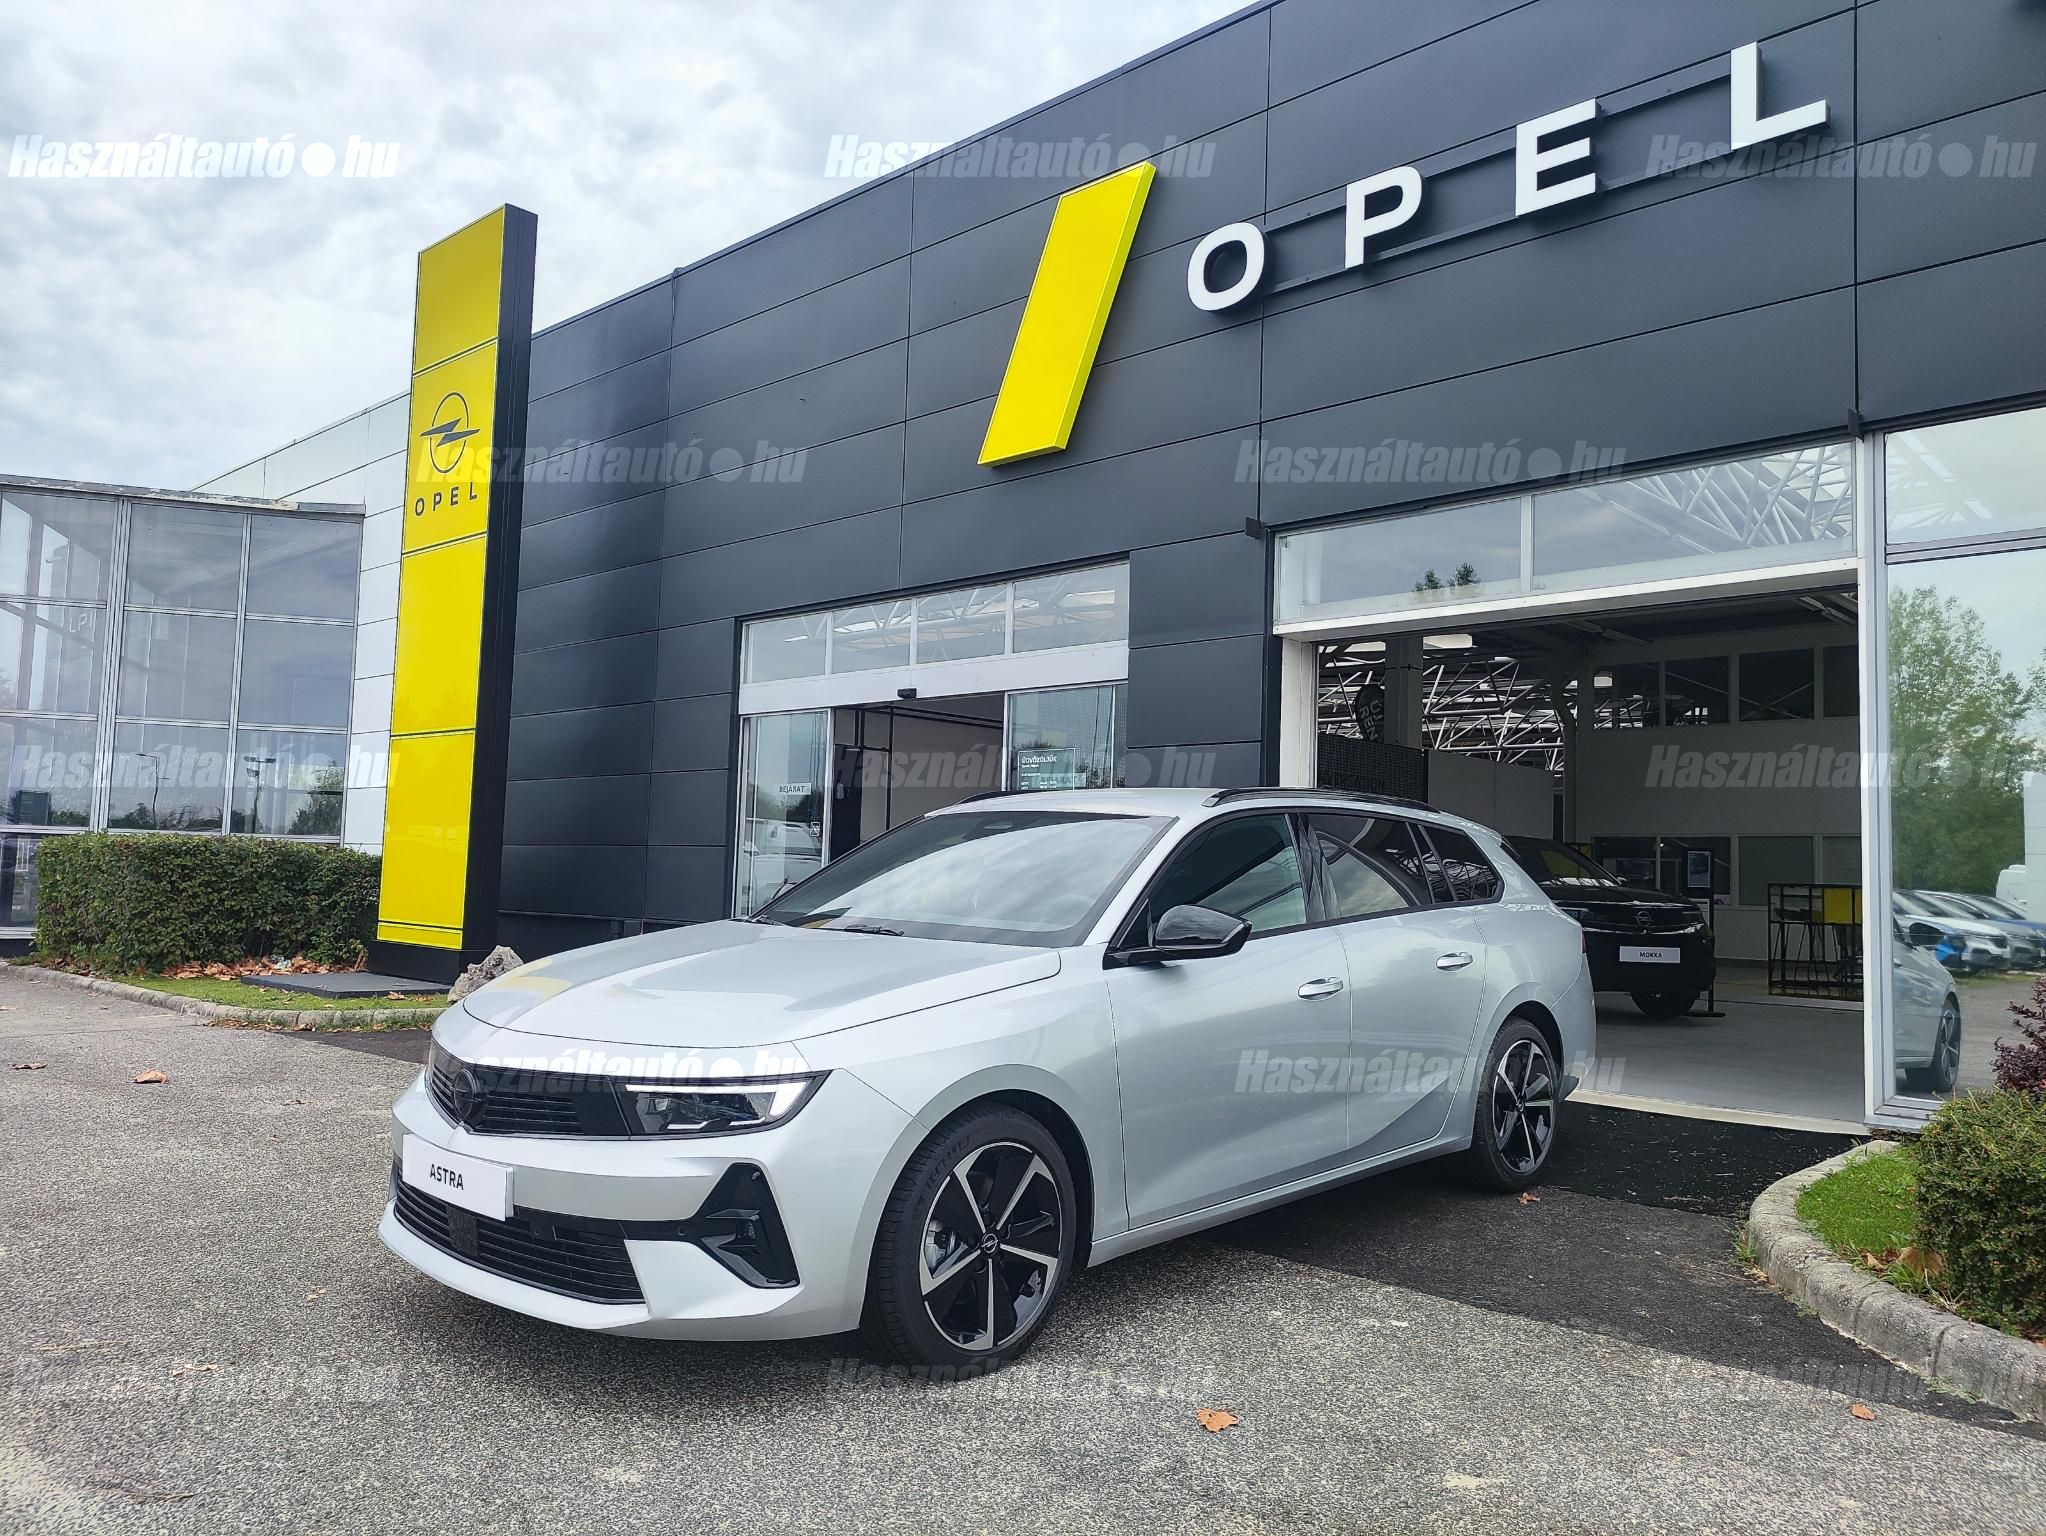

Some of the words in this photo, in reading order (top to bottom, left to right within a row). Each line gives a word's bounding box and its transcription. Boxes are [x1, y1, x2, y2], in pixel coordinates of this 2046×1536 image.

[1187, 41, 1828, 312] OPEL
[415, 482, 477, 517] OPEL
[430, 1164, 464, 1190] ASTRA
